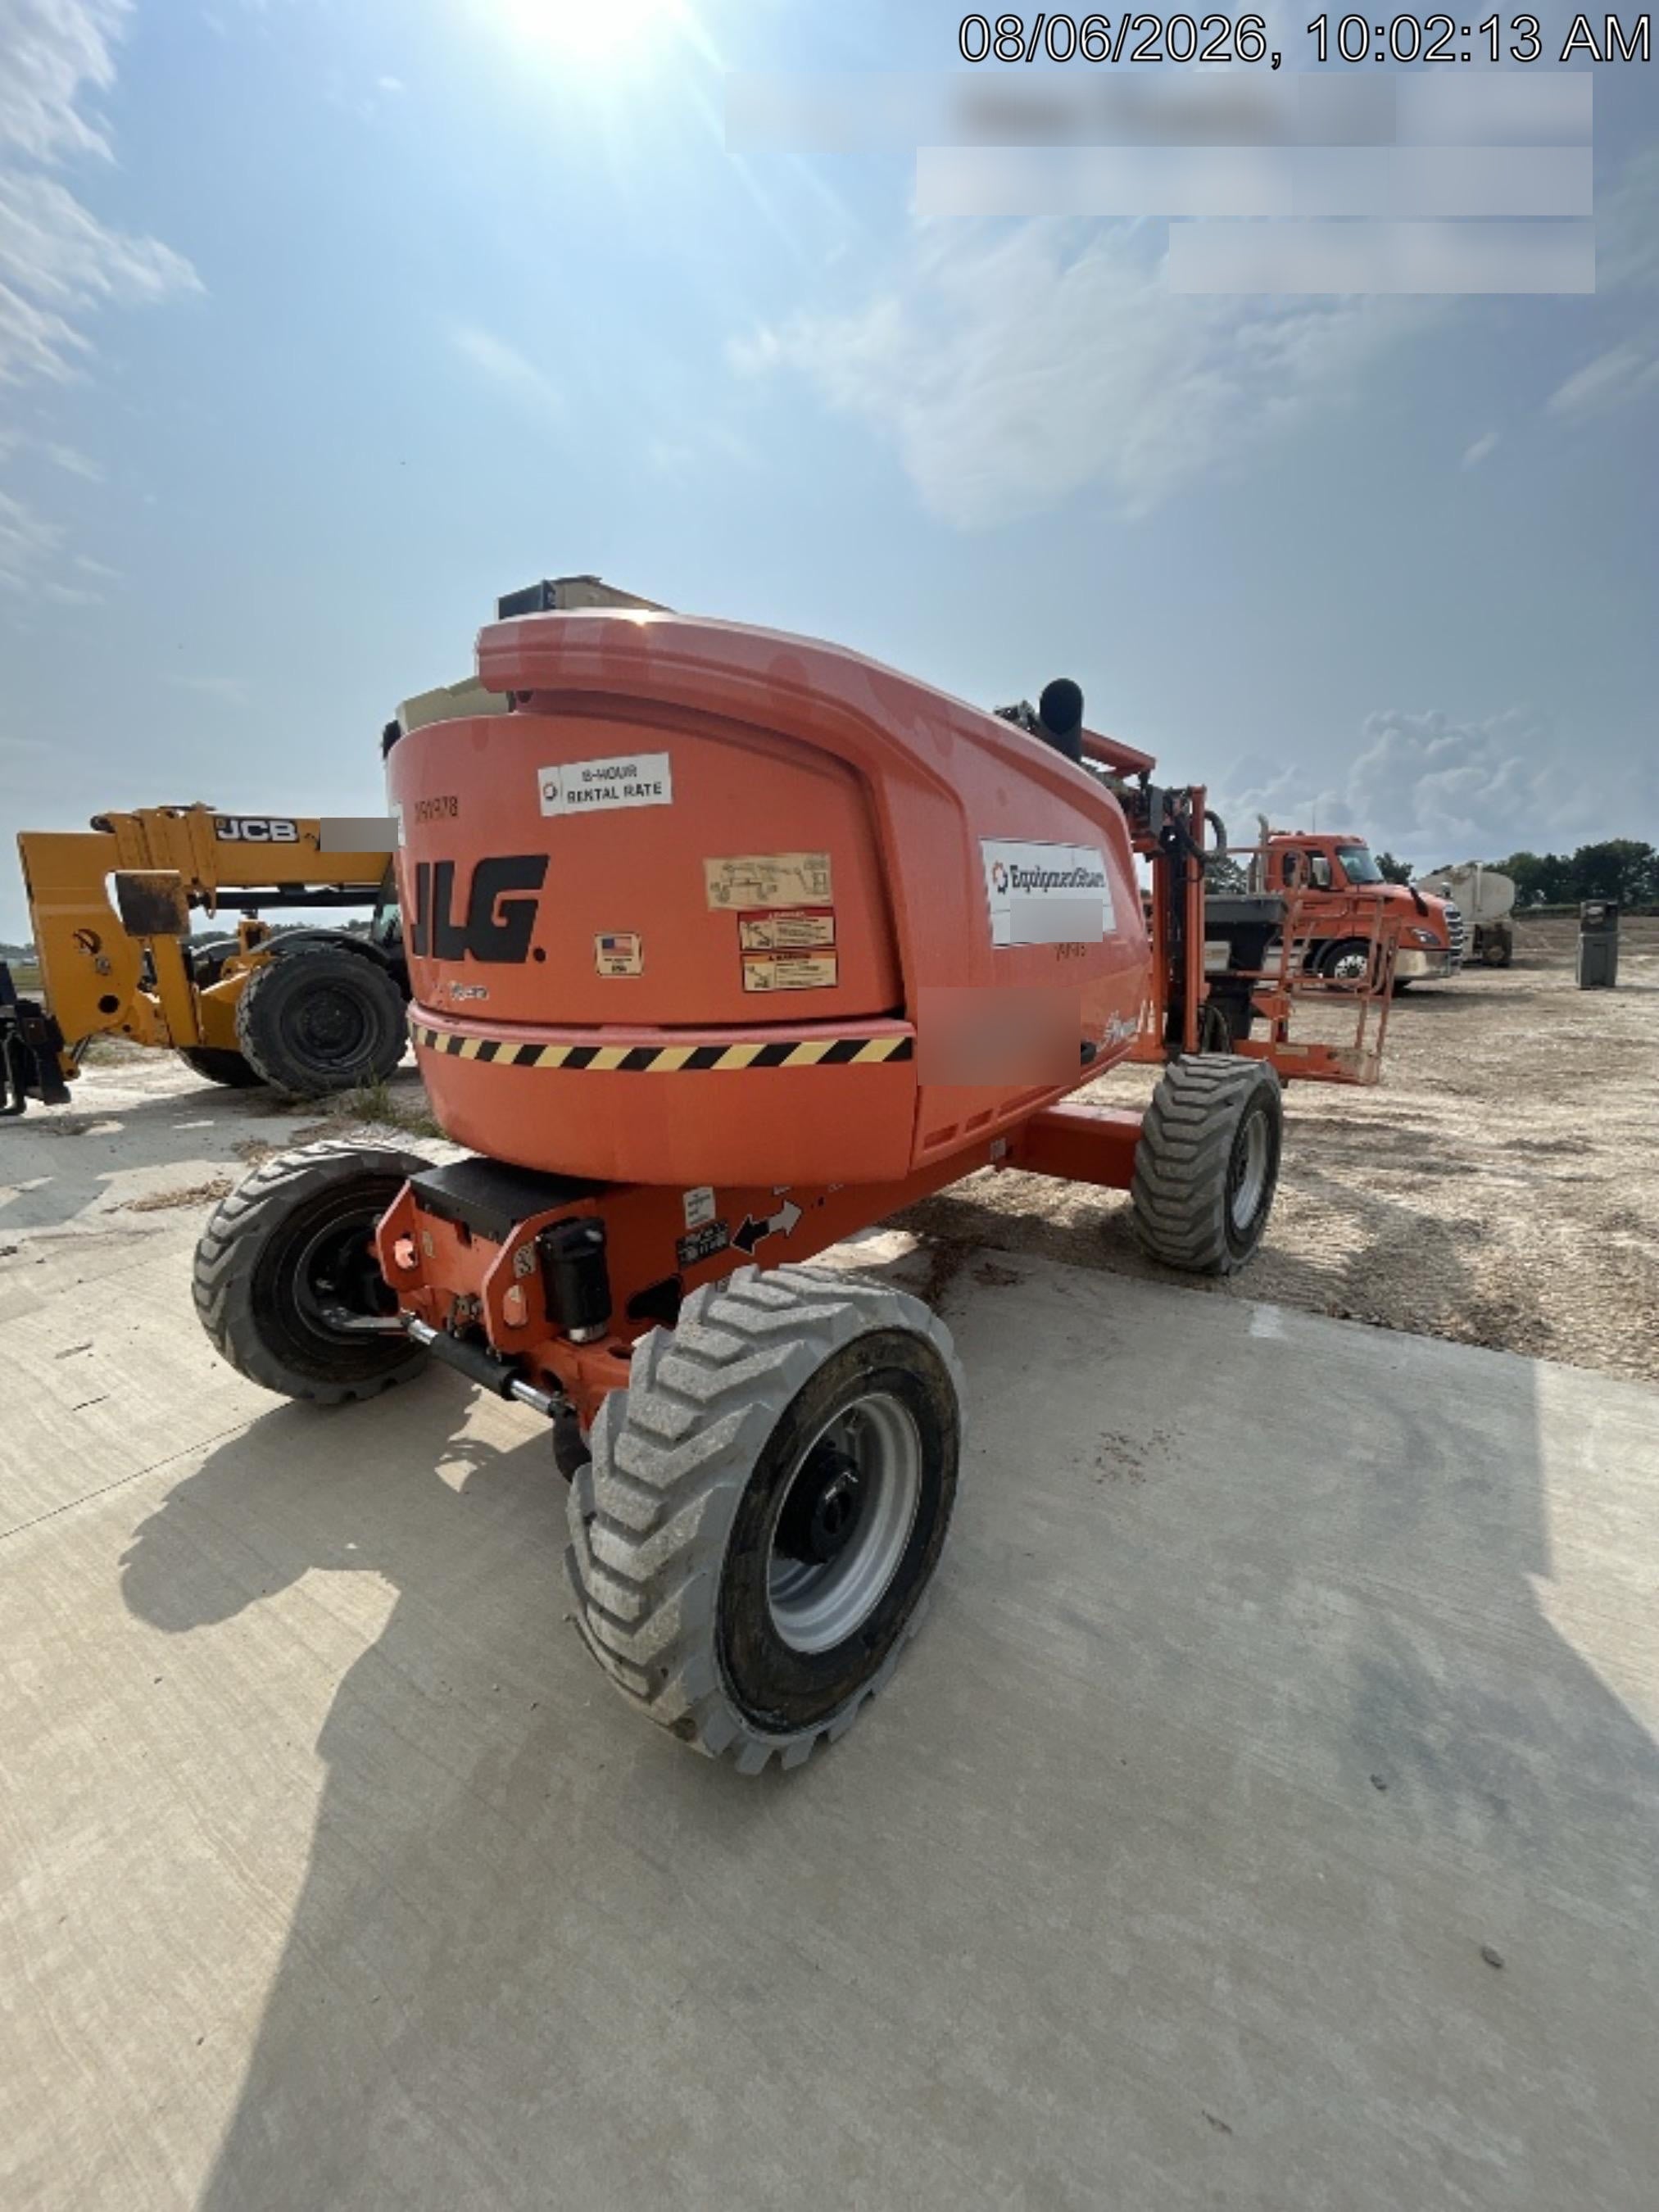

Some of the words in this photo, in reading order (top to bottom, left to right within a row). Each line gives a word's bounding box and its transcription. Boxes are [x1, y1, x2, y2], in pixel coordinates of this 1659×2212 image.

[567, 786, 619, 804] RENTAL
[624, 781, 662, 797] RATE
[216, 819, 297, 841] JCB
